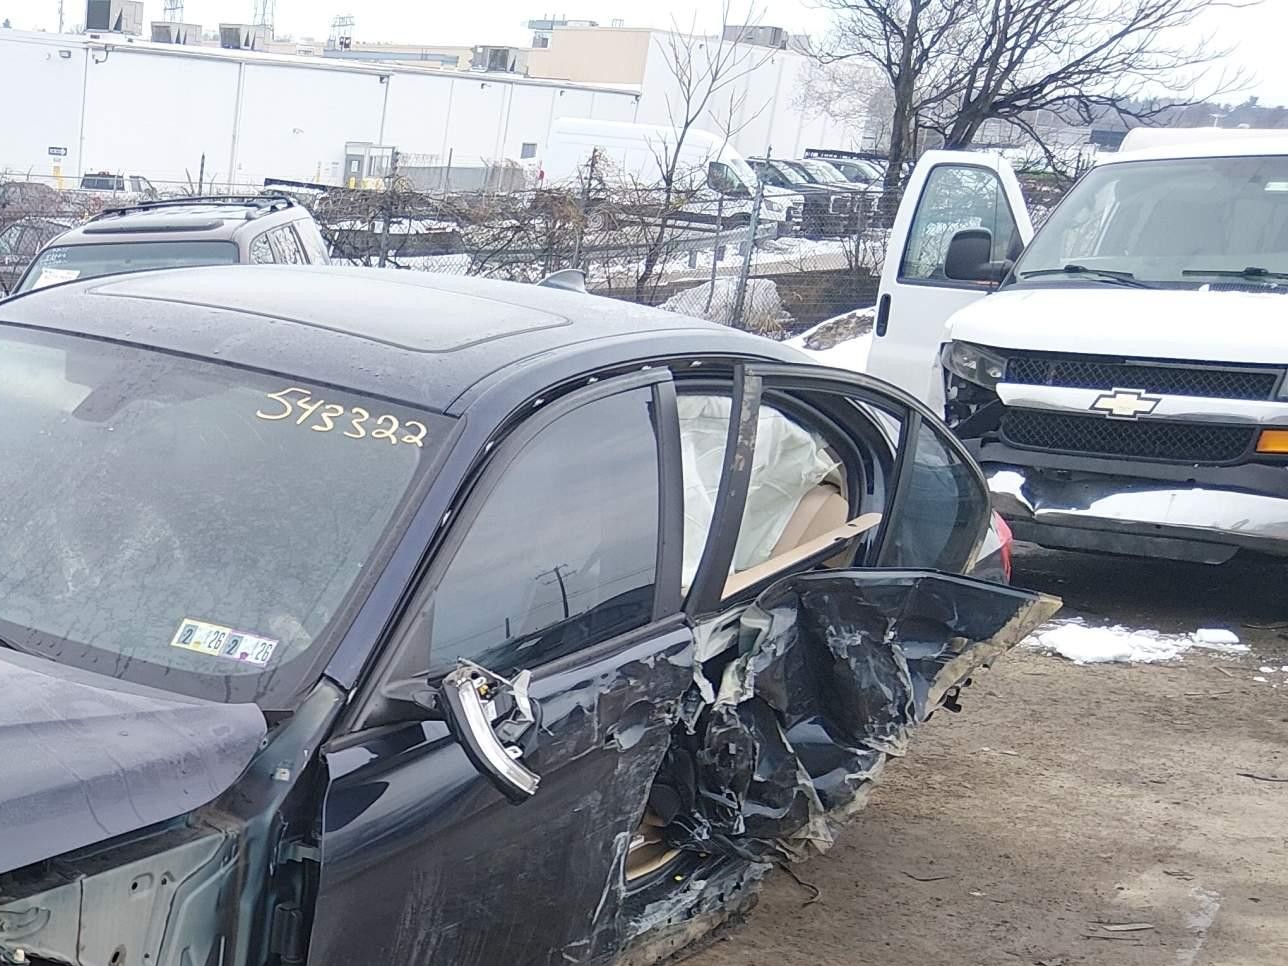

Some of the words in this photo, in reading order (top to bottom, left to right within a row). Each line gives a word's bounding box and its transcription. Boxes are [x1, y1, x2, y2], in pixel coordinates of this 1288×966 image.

[255, 387, 428, 448] 543322
[182, 628, 193, 645] 2
[207, 630, 226, 650] 26
[226, 639, 239, 656] 2
[255, 642, 273, 662] 26
